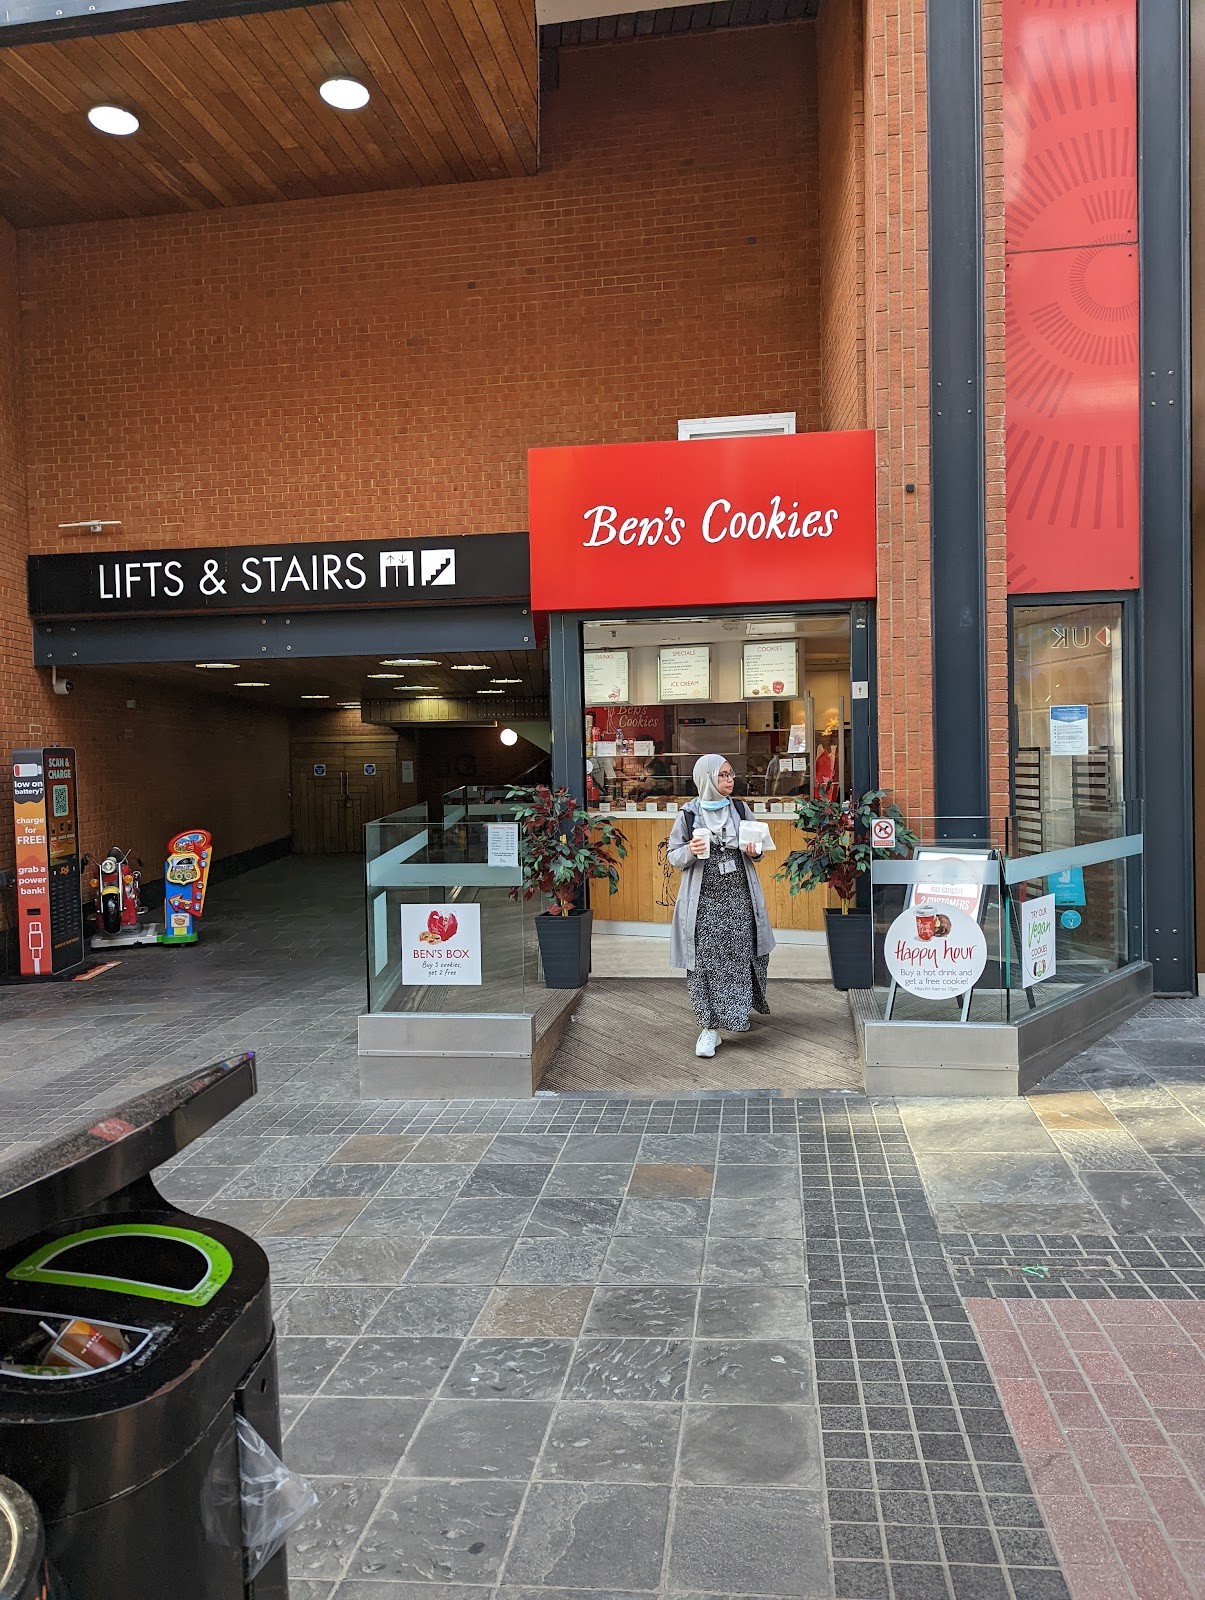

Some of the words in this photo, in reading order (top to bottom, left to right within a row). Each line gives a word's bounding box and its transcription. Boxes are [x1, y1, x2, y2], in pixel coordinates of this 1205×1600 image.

[583, 505, 686, 547] Ben's
[702, 496, 839, 543] Cookies
[99, 560, 184, 598] LIFTS
[199, 559, 228, 596] &
[241, 552, 366, 594] STAIRS
[618, 715, 658, 728] Cookies
[48, 758, 64, 768] SCAN
[65, 758, 70, 767] &
[48, 769, 71, 780] CHARGE
[17, 835, 46, 845] FREE!
[18, 866, 39, 875] grab
[19, 877, 47, 885] power
[20, 887, 45, 895] bank!
[1039, 908, 1047, 916] OUR
[1028, 921, 1050, 948] Vegan
[414, 950, 442, 958] BEN'S
[446, 950, 469, 958] BOX
[895, 940, 938, 968] Happy
[943, 940, 977, 963] hour
[1031, 944, 1048, 956] COOKIES
[900, 969, 914, 978] Buy
